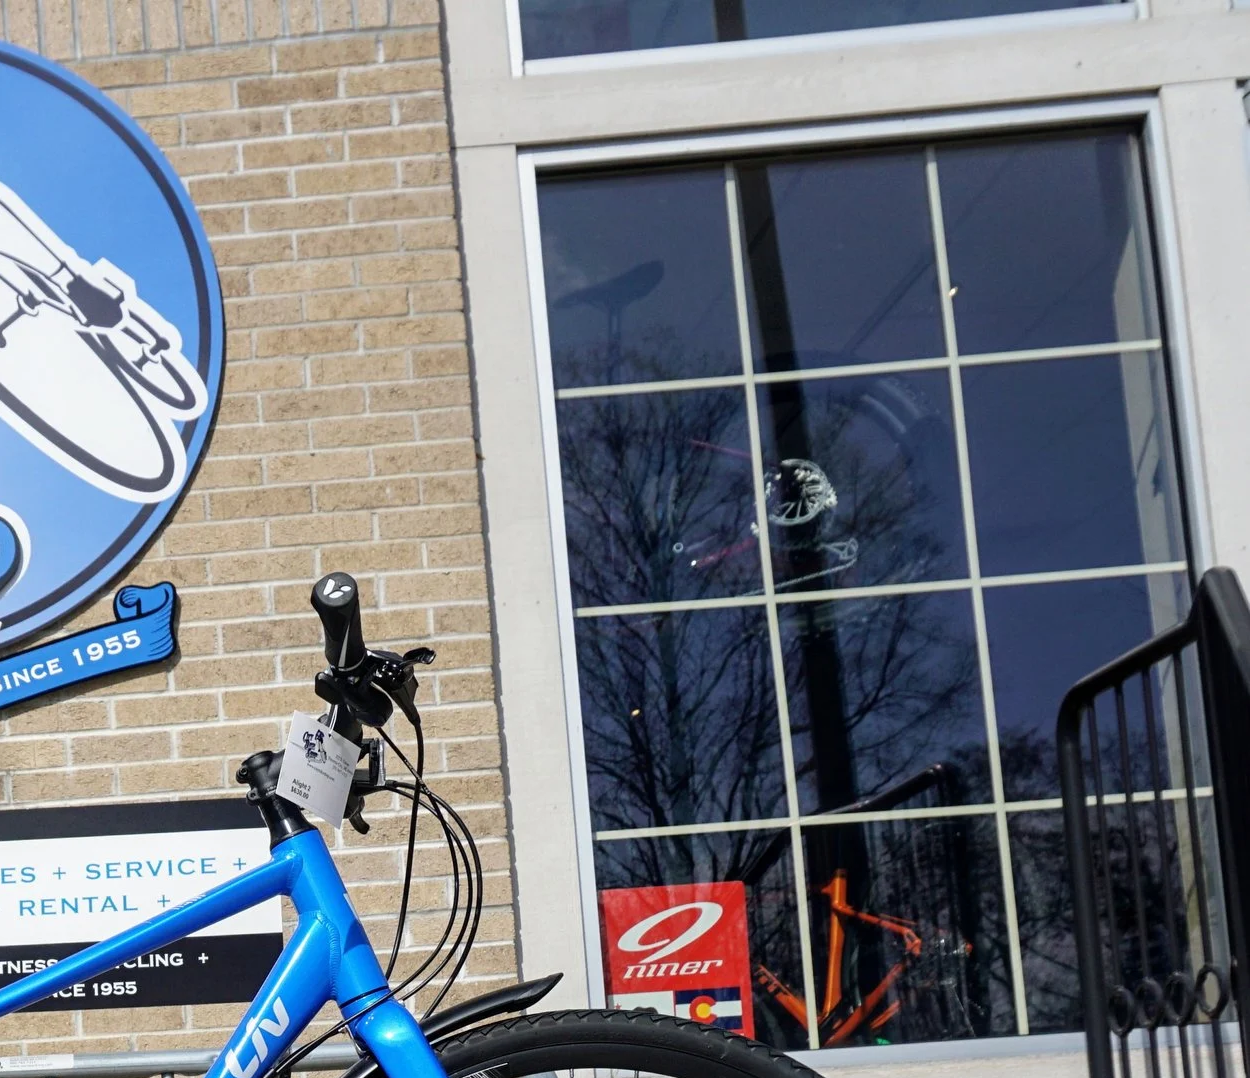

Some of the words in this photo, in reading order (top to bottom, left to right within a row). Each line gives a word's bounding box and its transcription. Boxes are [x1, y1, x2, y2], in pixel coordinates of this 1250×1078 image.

[71, 630, 141, 666] 1955
[86, 857, 217, 880] SERVICE
[19, 895, 138, 917] RENTAL
[92, 981, 138, 997] 1955
